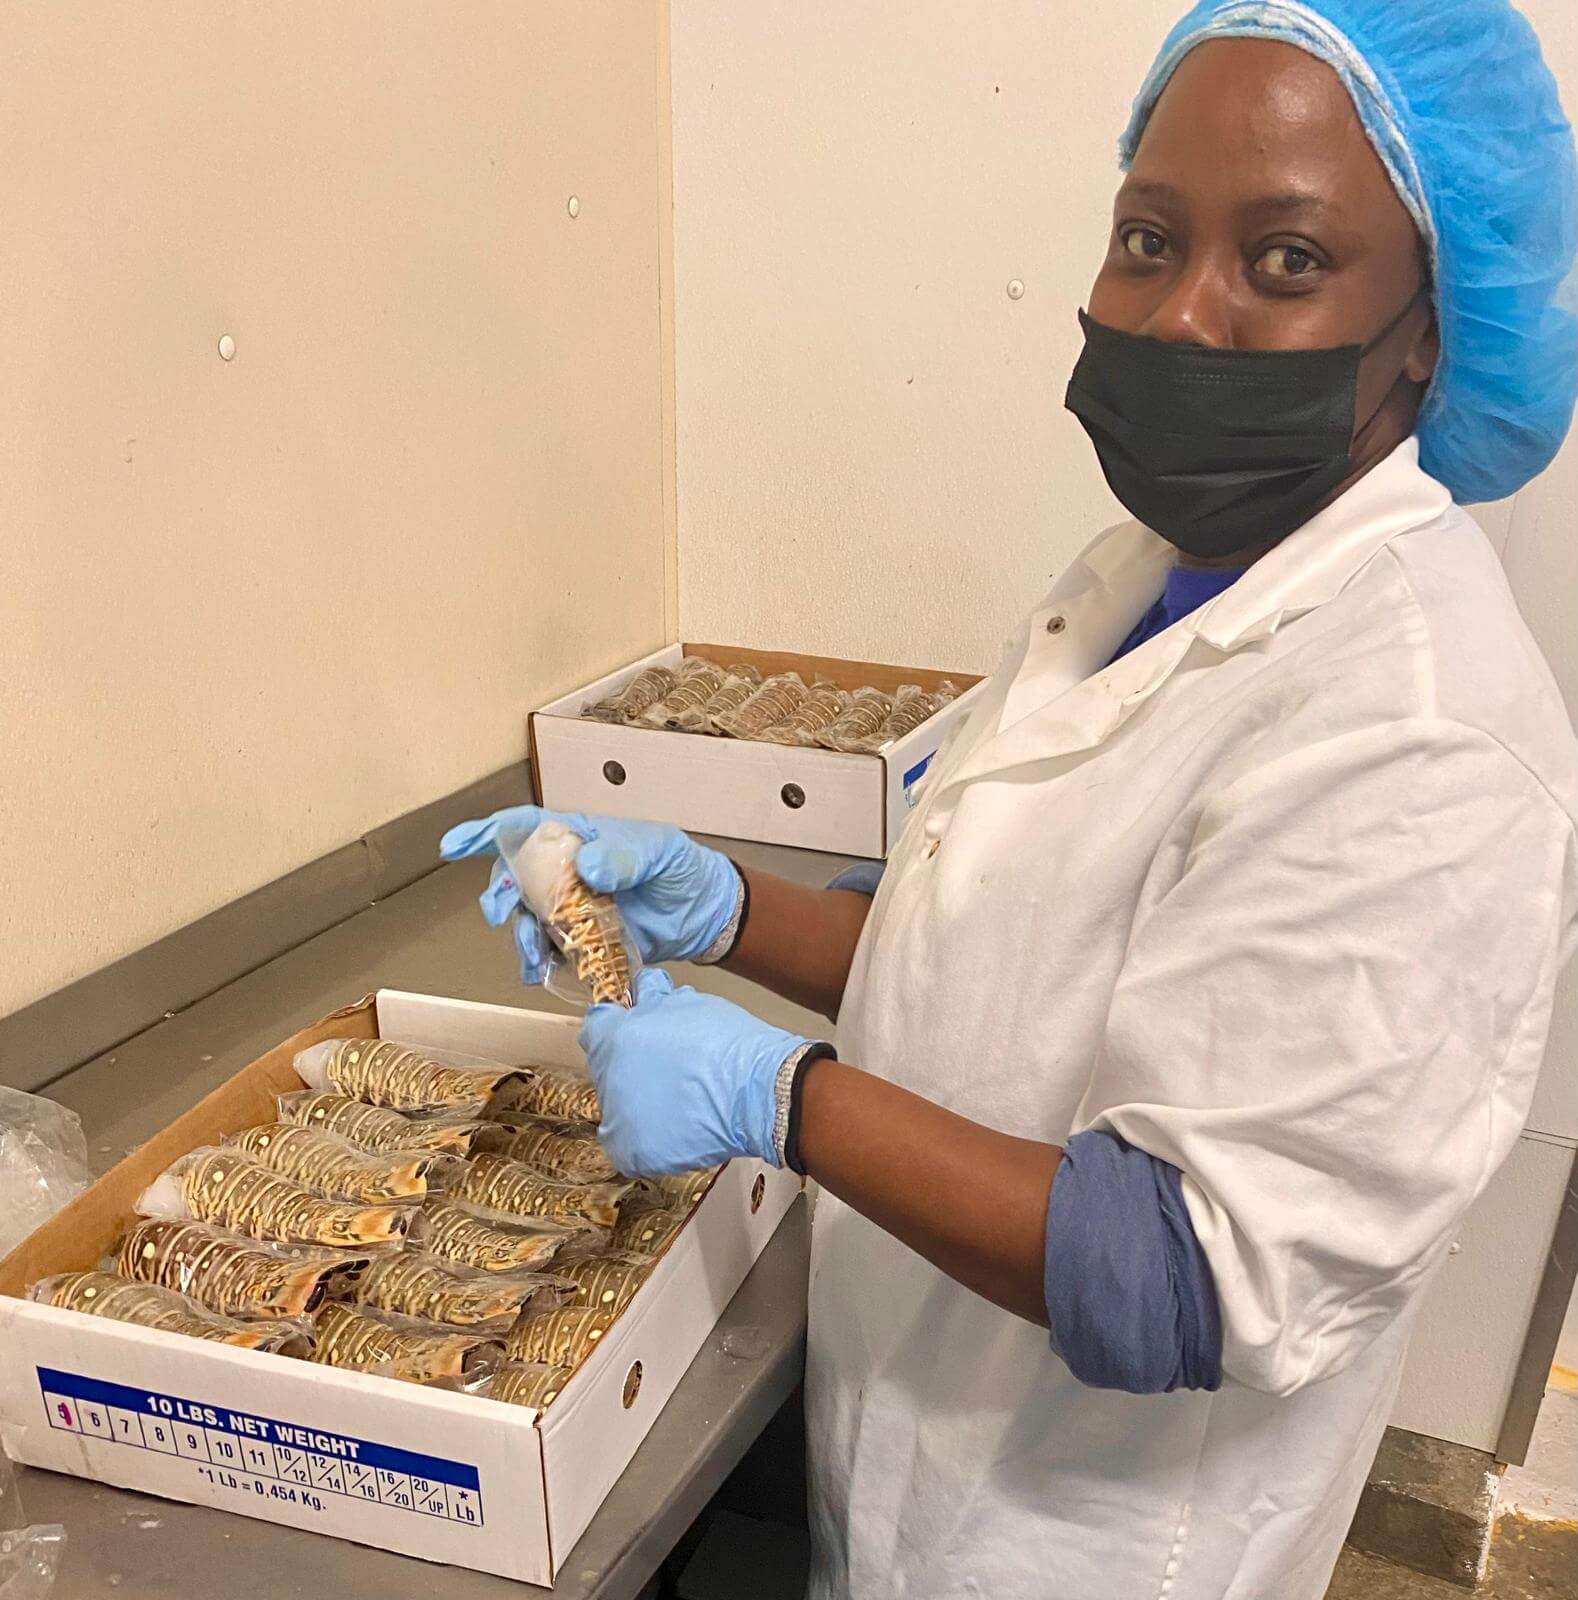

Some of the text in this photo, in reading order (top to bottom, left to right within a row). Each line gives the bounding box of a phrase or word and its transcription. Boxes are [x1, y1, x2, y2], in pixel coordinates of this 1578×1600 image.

[147, 1396, 360, 1458] 10 LBS. NET WEIGHT
[91, 1412, 101, 1427] 6
[120, 1419, 129, 1433] 7
[155, 1426, 165, 1442] 8
[187, 1434, 197, 1449] 9
[216, 1442, 233, 1458] 10
[249, 1449, 265, 1466] 11
[455, 1504, 475, 1522] Lb
[220, 1472, 237, 1489] Lb
[254, 1480, 297, 1503] 0,454
[301, 1491, 327, 1511] Kg.
